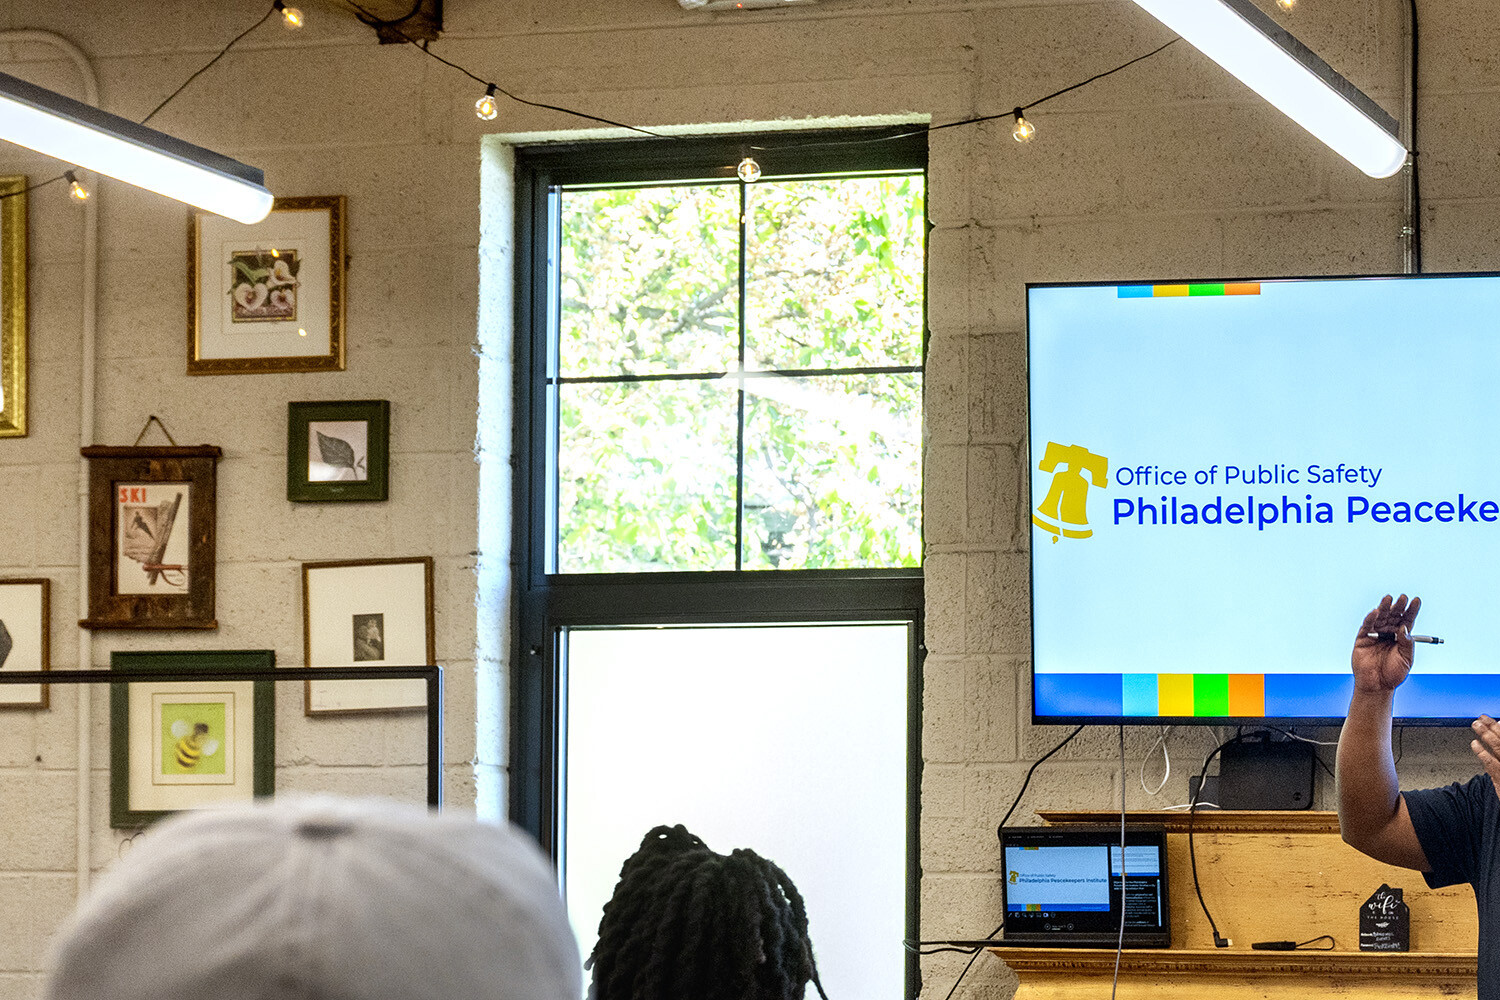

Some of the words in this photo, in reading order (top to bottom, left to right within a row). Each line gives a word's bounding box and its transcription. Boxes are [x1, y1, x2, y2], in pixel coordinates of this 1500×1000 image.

[1115, 466, 1187, 485] Office
[1194, 465, 1218, 485] of
[1225, 464, 1300, 484] Public
[1307, 463, 1383, 488] Safety
[119, 487, 147, 503] SKI
[1113, 494, 1334, 531] Philadelphia
[1368, 895, 1401, 915] wifi
